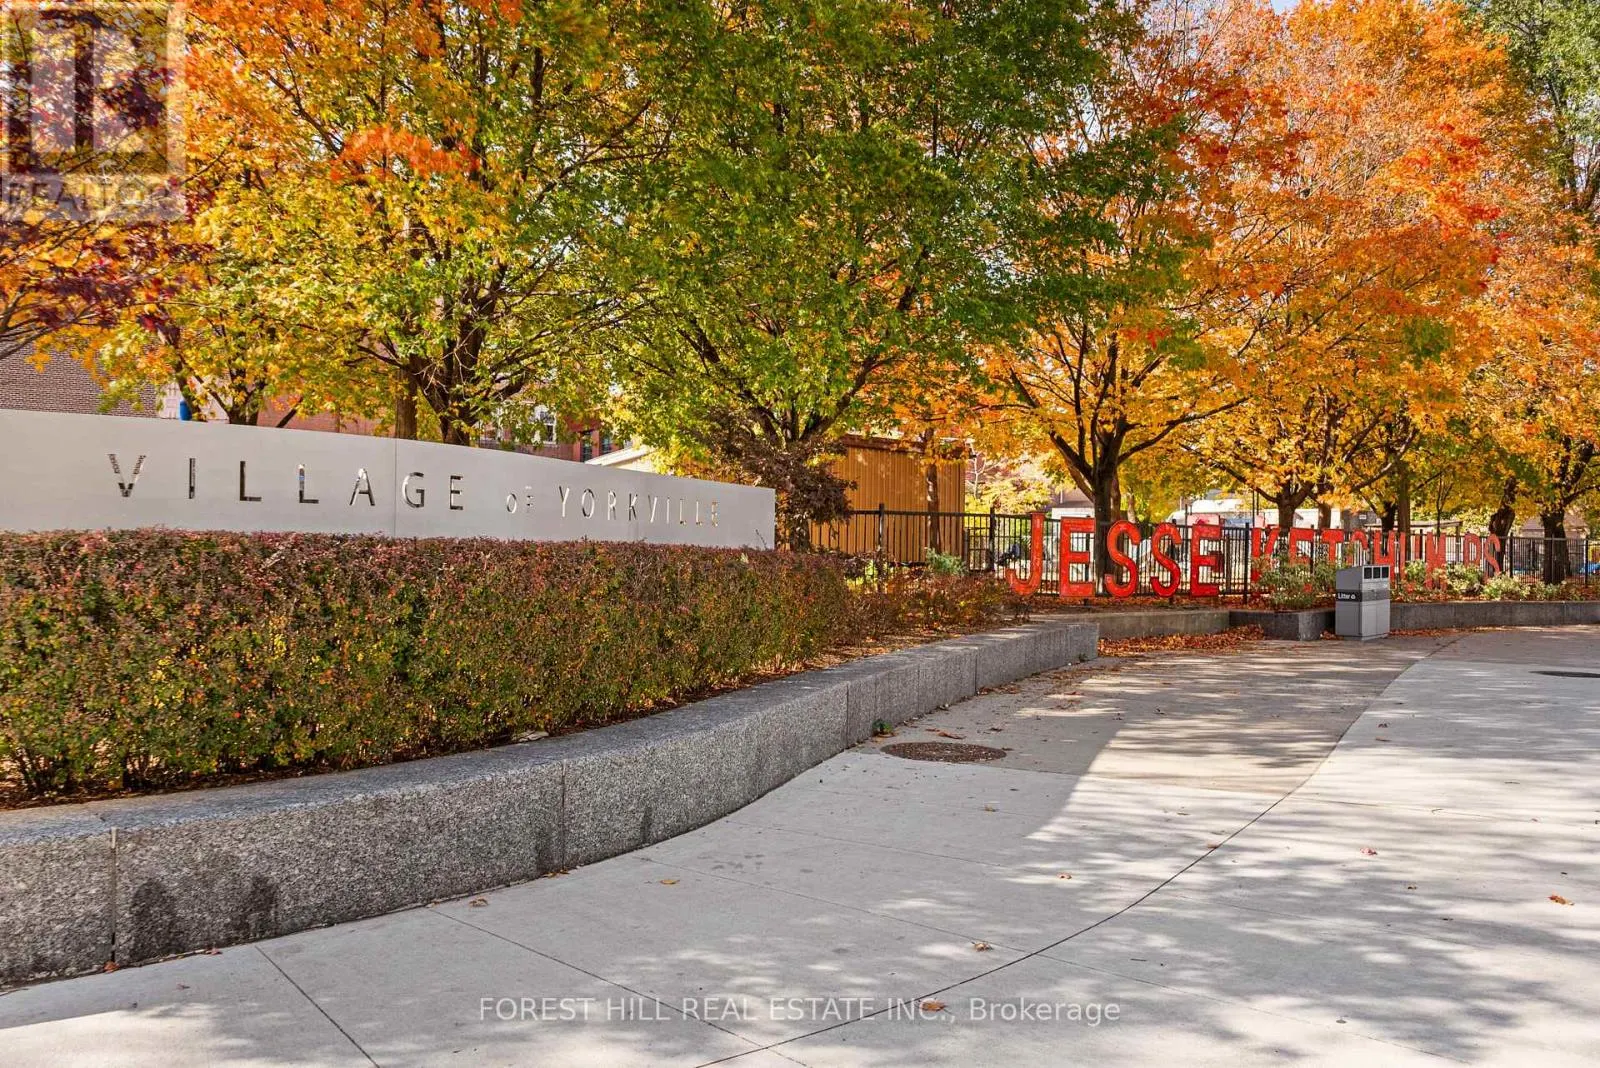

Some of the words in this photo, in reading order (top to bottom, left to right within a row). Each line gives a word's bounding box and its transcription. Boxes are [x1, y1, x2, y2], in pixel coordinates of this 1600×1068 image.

[108, 453, 464, 511] VILLAGE
[558, 485, 719, 527] YORKVILLE
[1005, 512, 1221, 598] JESSE
[1337, 592, 1350, 600] Litter
